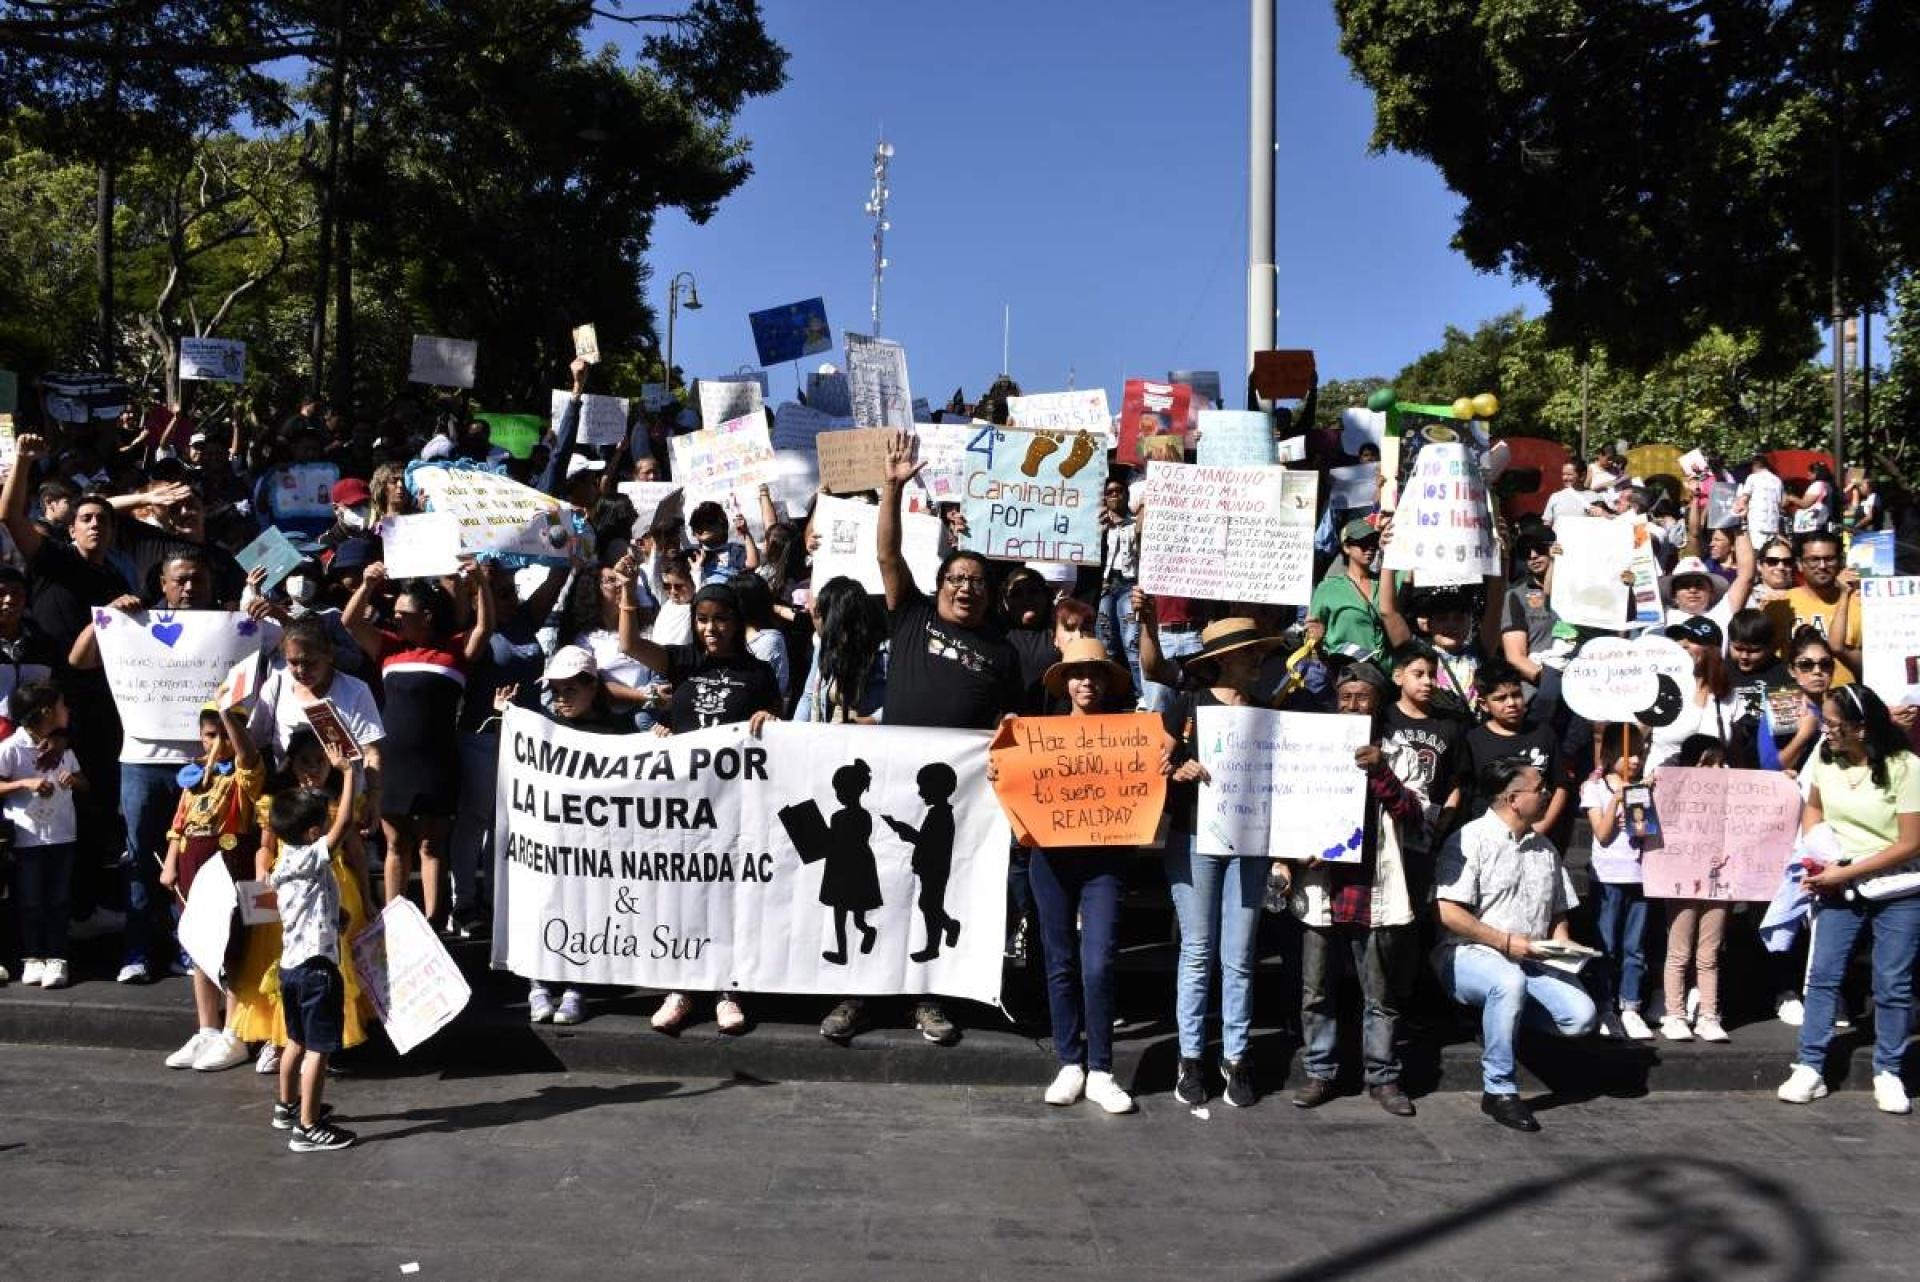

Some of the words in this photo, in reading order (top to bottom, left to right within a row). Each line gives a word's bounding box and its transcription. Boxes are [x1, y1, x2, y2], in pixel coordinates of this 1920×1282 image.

[967, 471, 1080, 508] Caminata
[1053, 511, 1070, 536] la
[1417, 506, 1441, 527] los
[986, 527, 1085, 562] Lectura
[1119, 726, 1150, 748] vida
[514, 731, 675, 781] CAMINATA
[689, 747, 769, 781] POR
[1032, 766, 1054, 781] un
[1127, 750, 1146, 773] de
[512, 778, 537, 817] LA
[543, 789, 718, 830] LECTURA
[1060, 782, 1107, 801] sueño
[1118, 782, 1149, 798] una
[506, 831, 614, 878] ARGENTINA
[621, 850, 735, 883] NARRADA
[742, 852, 774, 883] AC
[615, 886, 641, 915] &
[543, 916, 640, 966] Qadia
[650, 924, 711, 961] Sur
